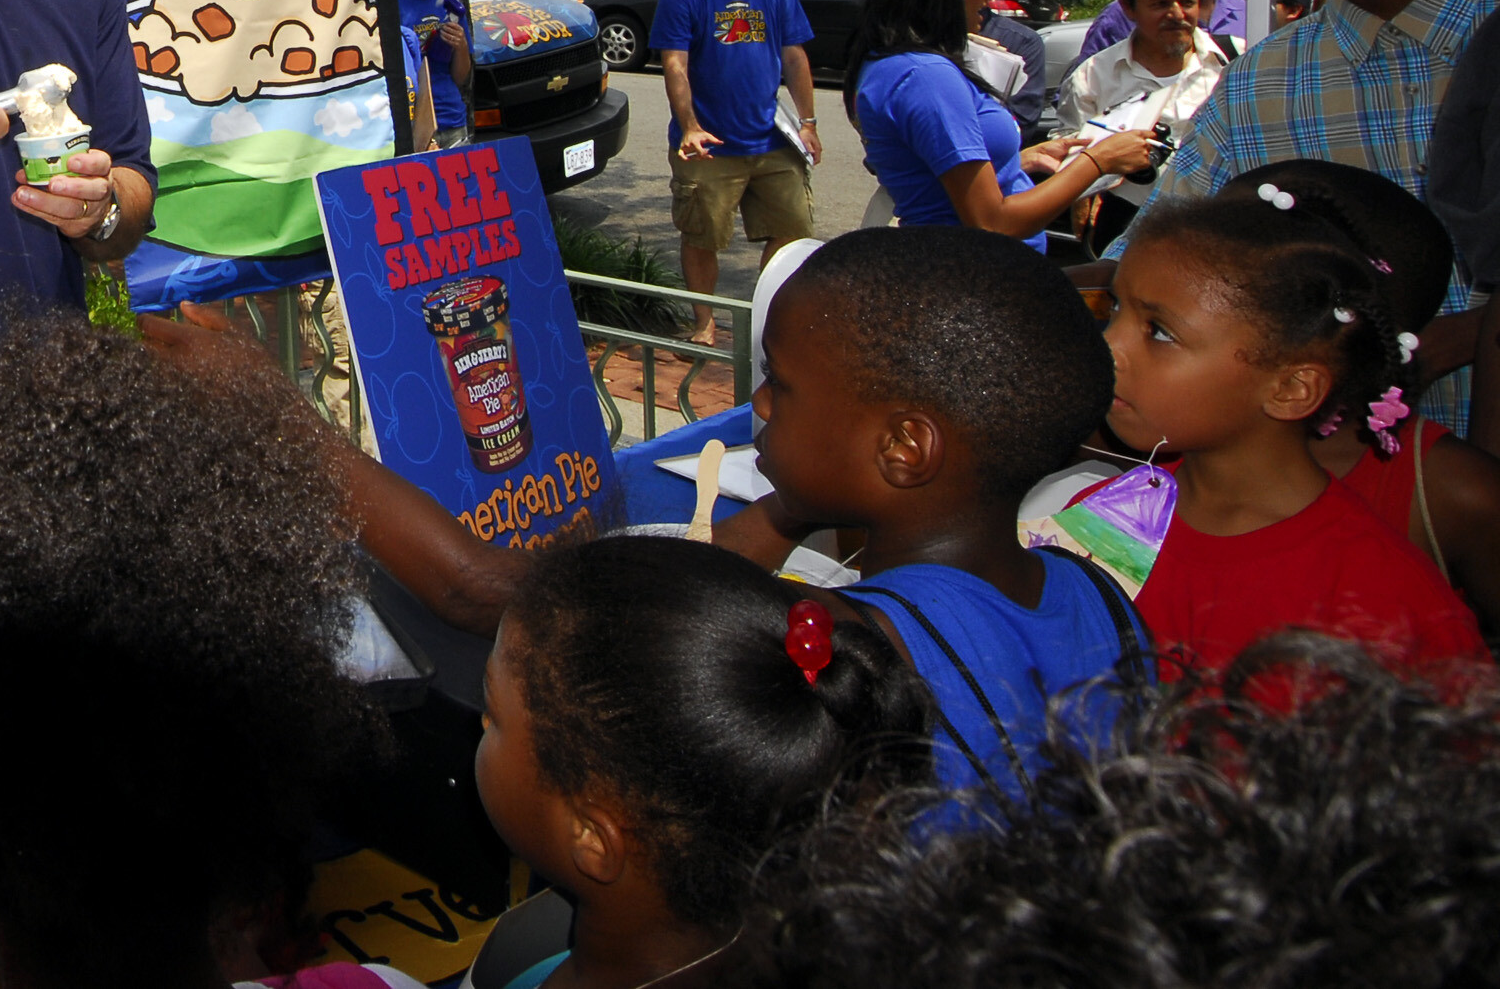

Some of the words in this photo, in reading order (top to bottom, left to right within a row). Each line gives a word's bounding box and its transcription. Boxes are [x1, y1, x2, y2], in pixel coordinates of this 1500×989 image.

[516, 19, 573, 43] TOUR
[736, 30, 766, 43] TOUR
[361, 147, 512, 247] FREE
[384, 219, 521, 291] SAMPLES
[467, 372, 511, 403] American
[482, 396, 501, 415] Pie
[555, 451, 601, 504] Pie
